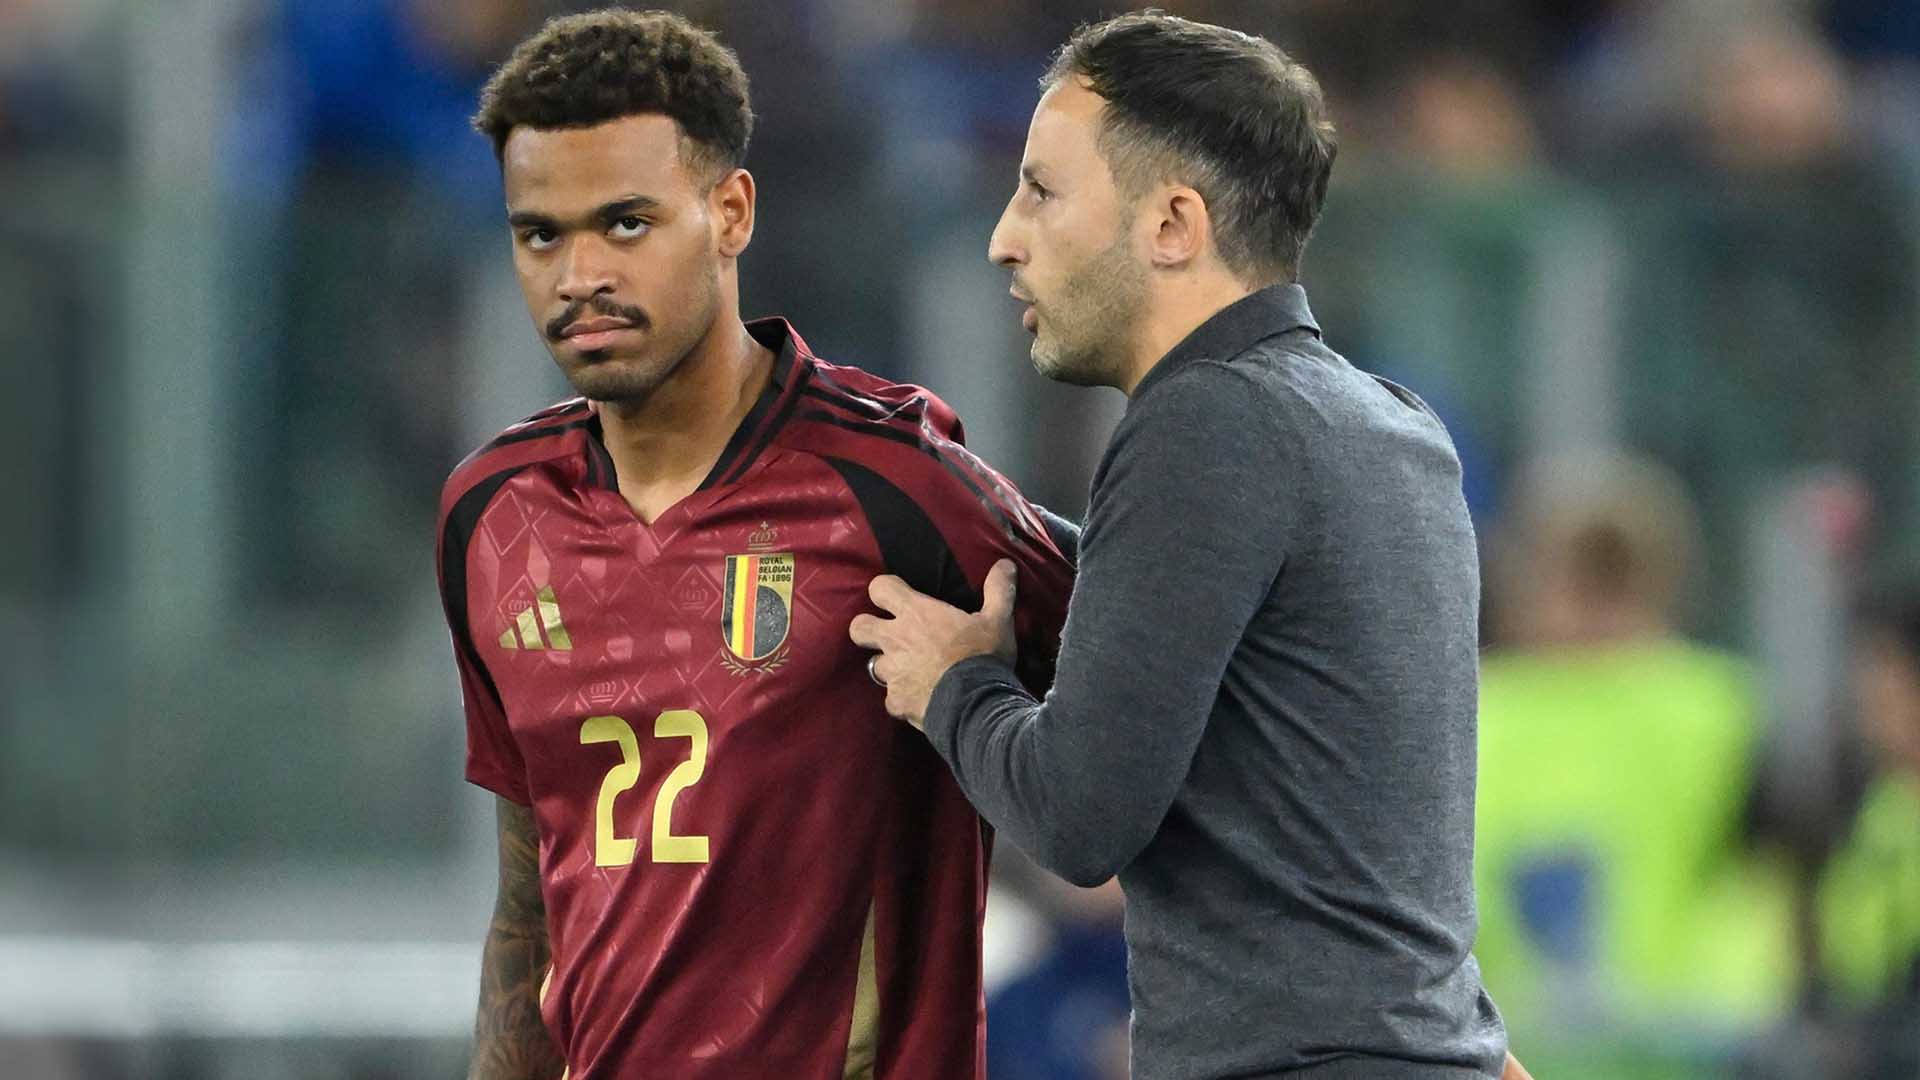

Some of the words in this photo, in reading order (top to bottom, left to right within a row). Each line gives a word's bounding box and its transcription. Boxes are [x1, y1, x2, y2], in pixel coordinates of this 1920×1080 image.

[759, 557, 783, 565] ROYAL
[759, 565, 792, 573] BELGIAN
[580, 710, 709, 867] 22
